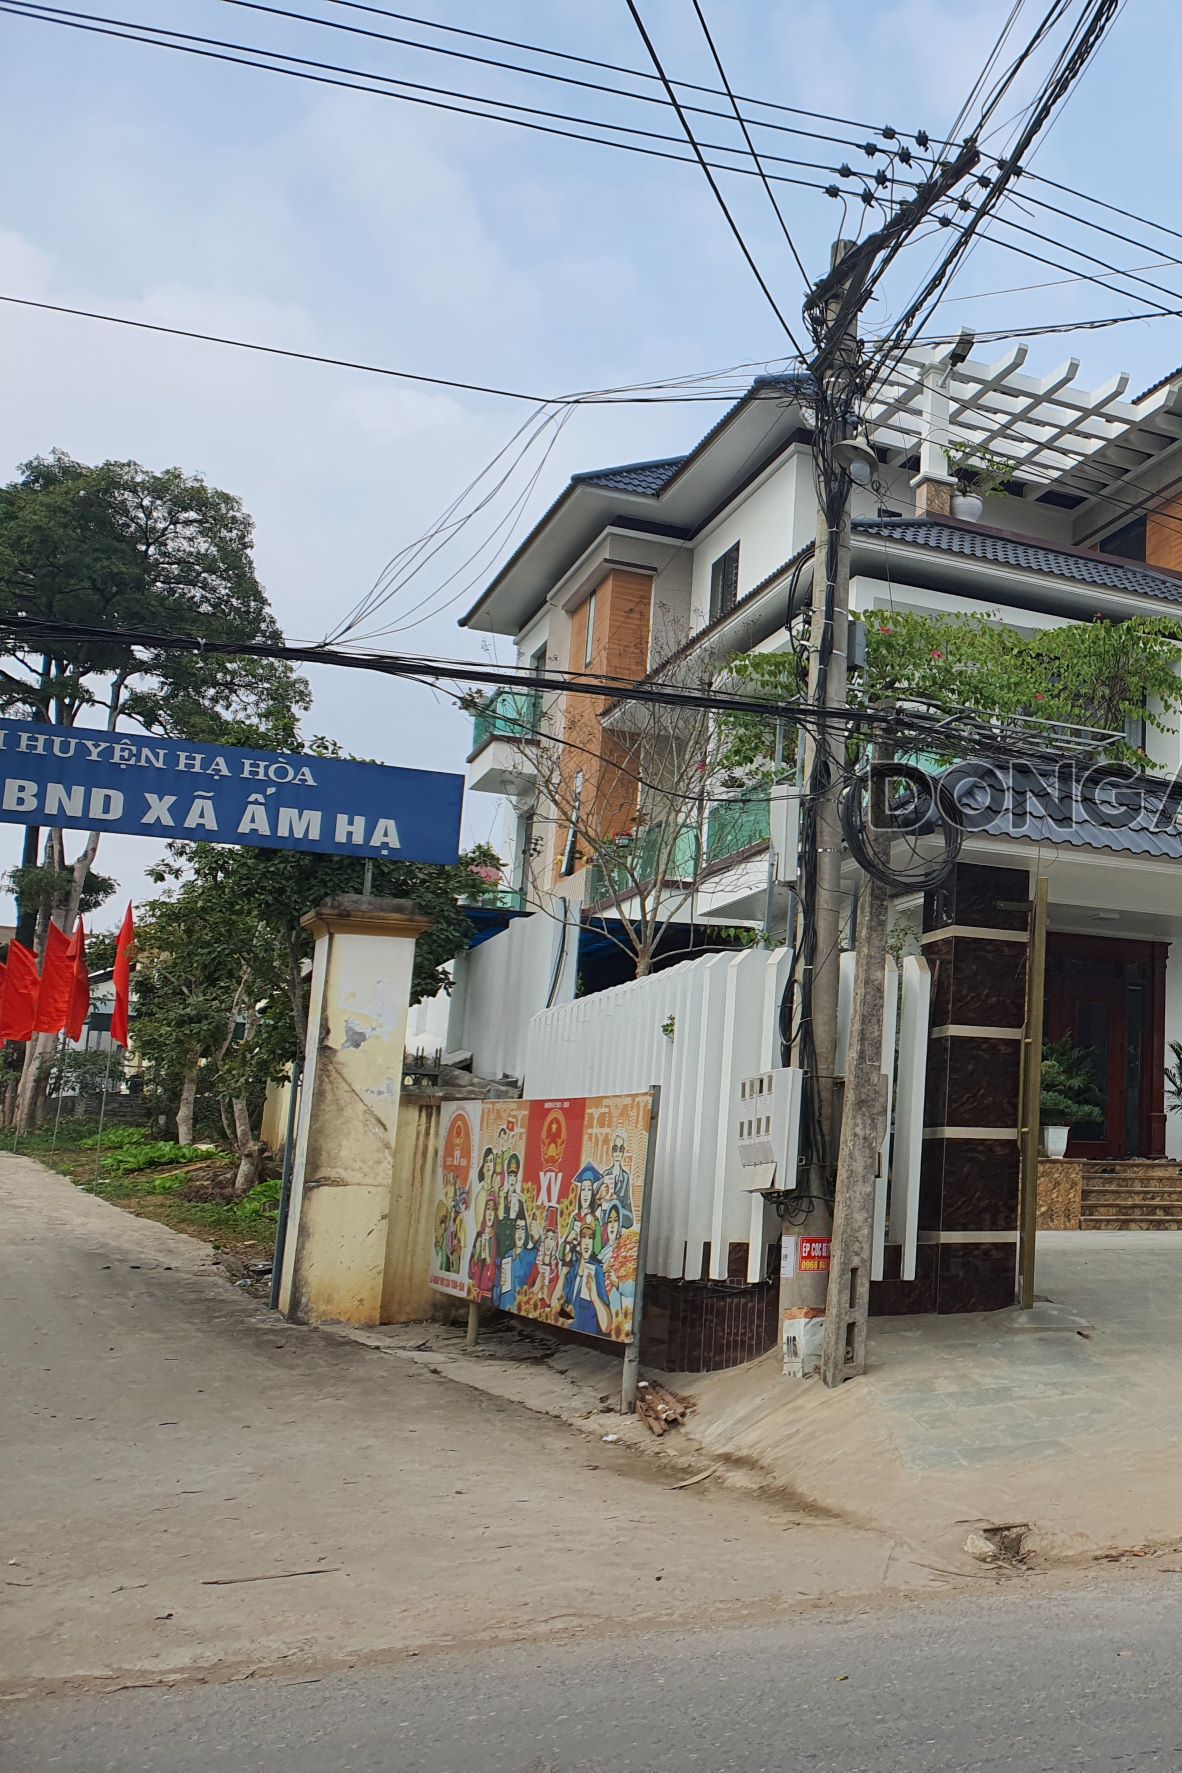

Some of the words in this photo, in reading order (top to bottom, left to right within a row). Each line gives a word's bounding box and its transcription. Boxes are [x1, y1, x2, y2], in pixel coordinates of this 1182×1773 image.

[16, 731, 168, 769] HUYỆN
[175, 752, 232, 780] HẠ
[240, 757, 318, 786] HÒA
[140, 790, 219, 831] XÃ
[237, 787, 322, 840] ẤM
[335, 813, 402, 855] HẠ
[537, 1171, 563, 1205] XV
